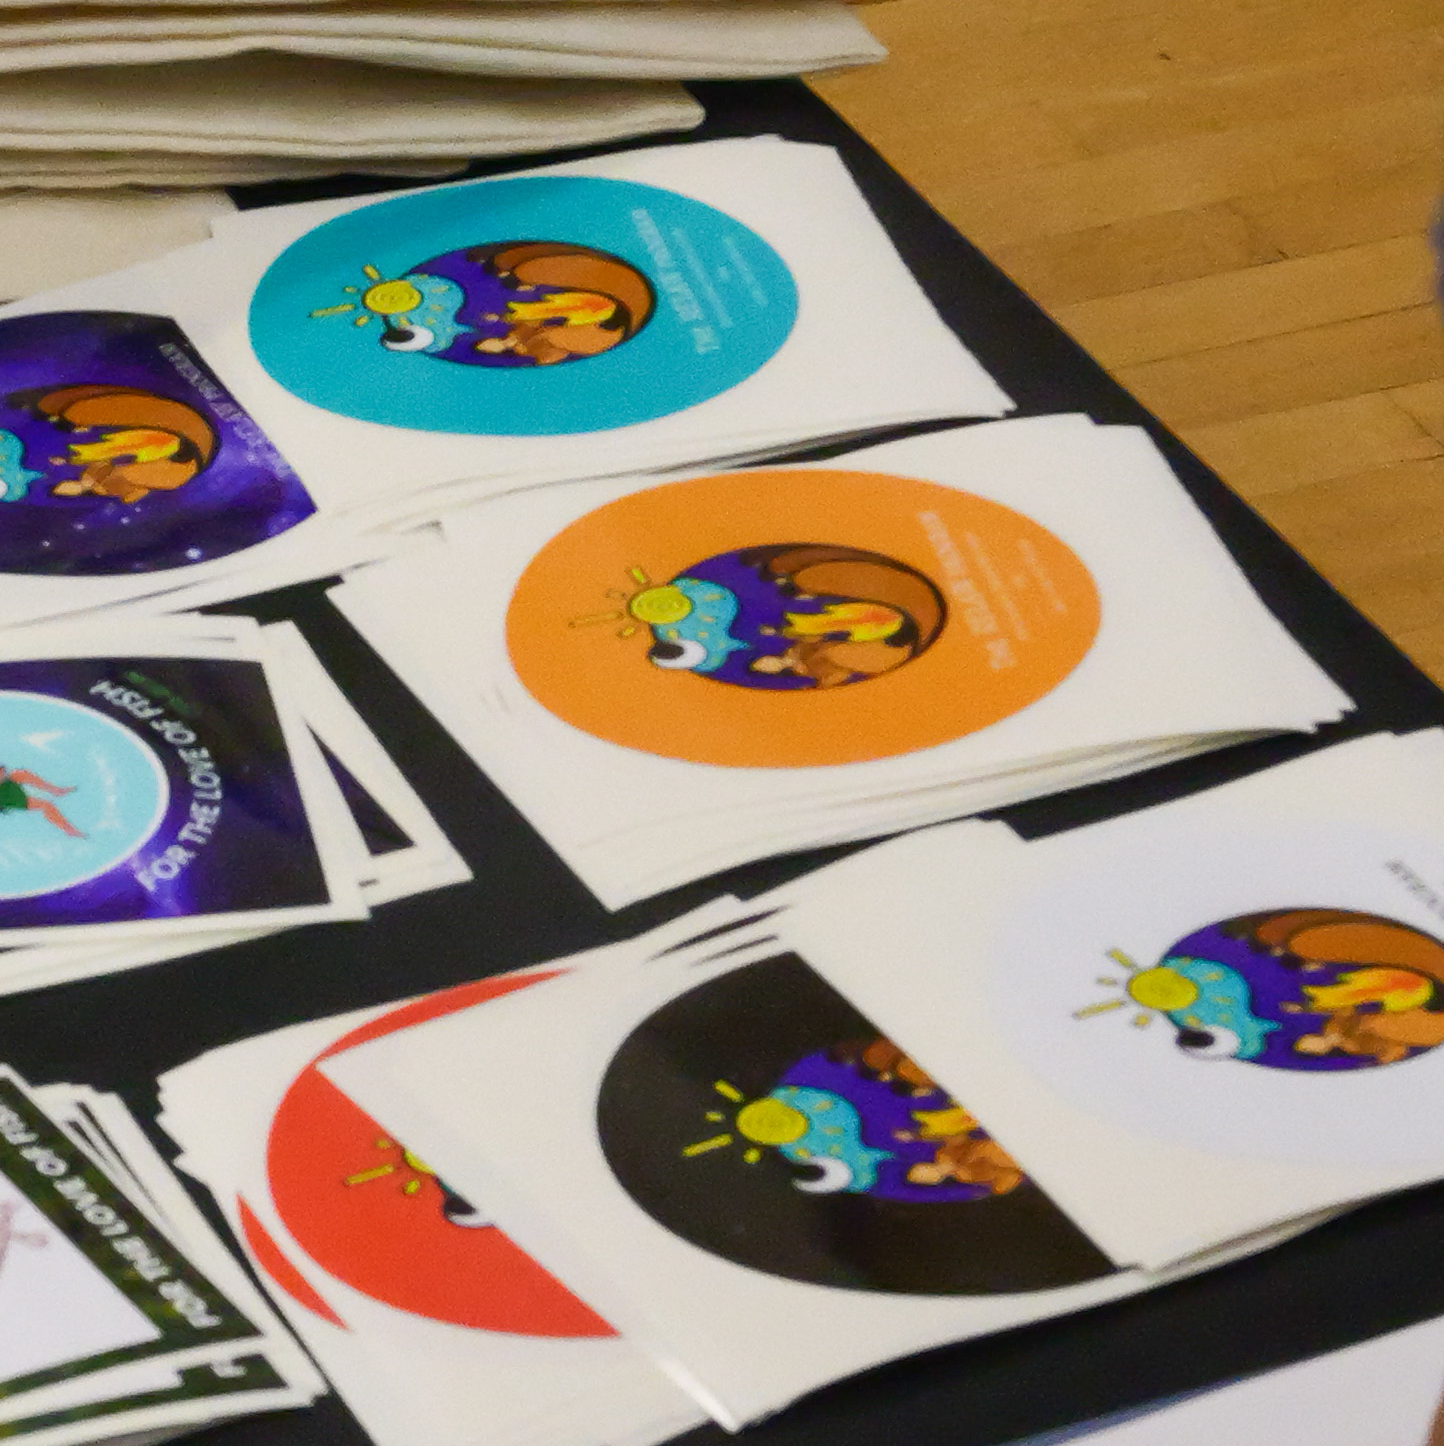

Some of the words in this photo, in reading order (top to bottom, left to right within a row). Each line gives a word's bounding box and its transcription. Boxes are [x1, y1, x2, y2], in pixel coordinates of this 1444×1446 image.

[88, 678, 165, 720] FISH
[148, 719, 198, 745] OF
[176, 746, 223, 801] LOVE
[176, 799, 222, 844] THE
[134, 843, 198, 893] FOR
[18, 1145, 69, 1177] OF
[52, 1175, 130, 1237] LOVE
[111, 1235, 170, 1282] THE
[158, 1278, 224, 1329] FOR
